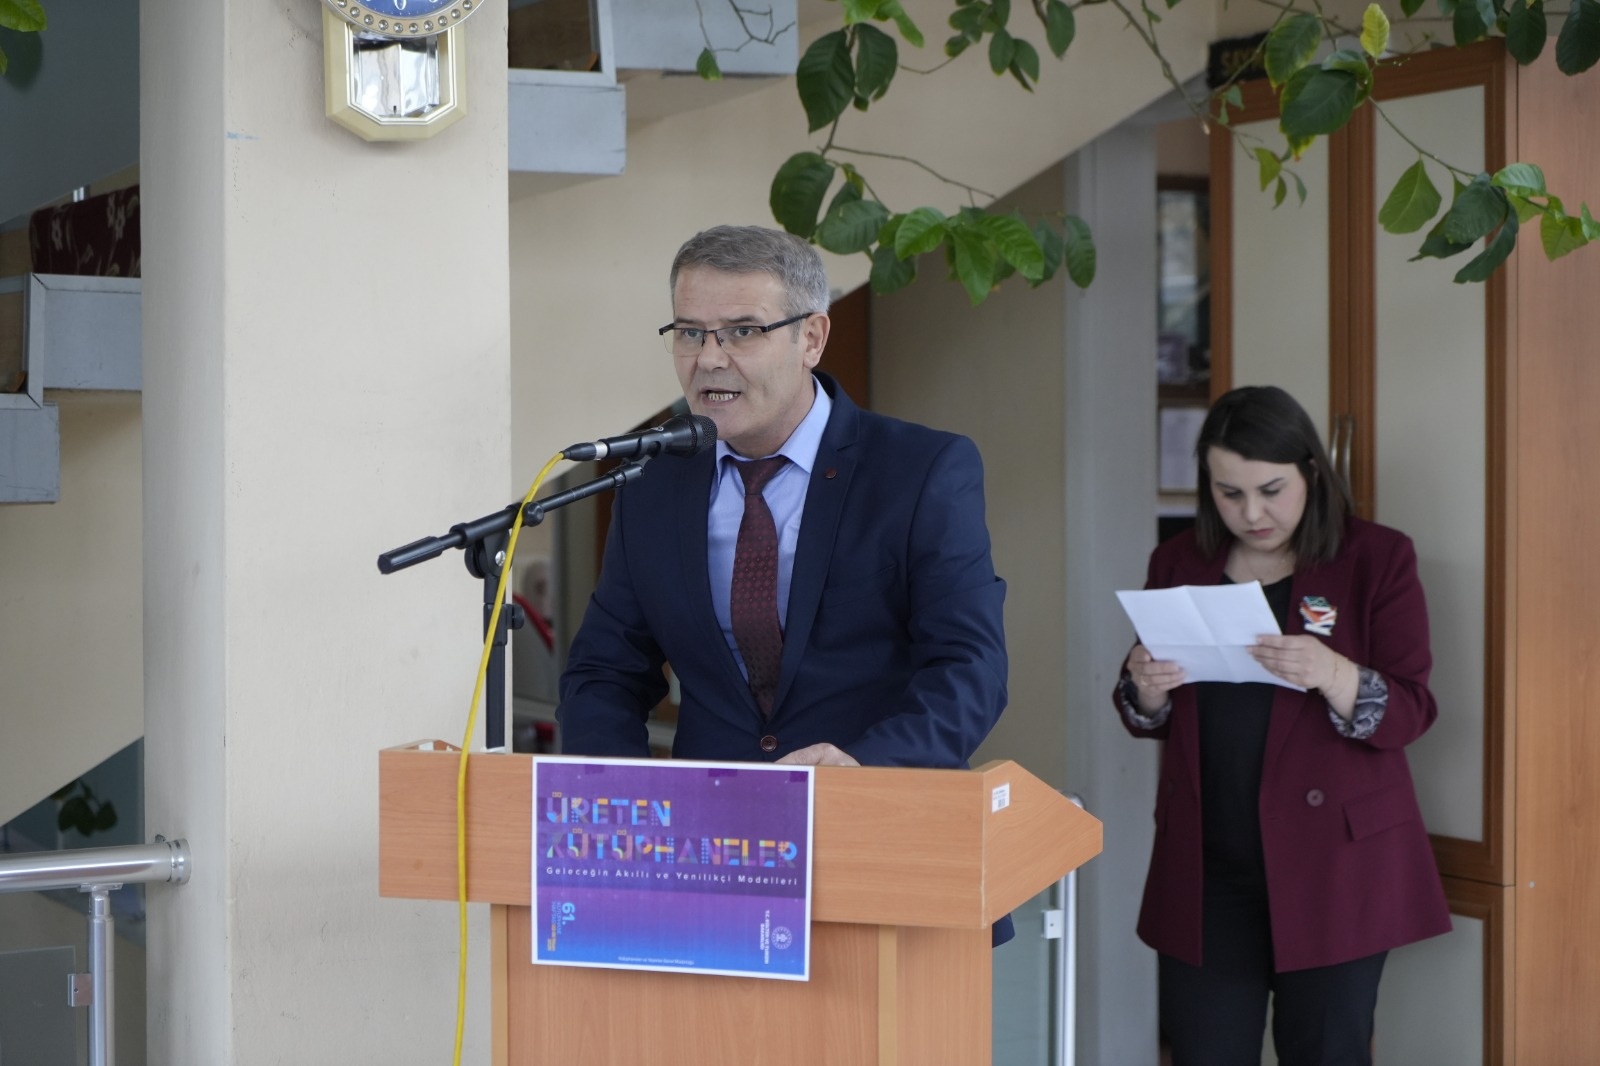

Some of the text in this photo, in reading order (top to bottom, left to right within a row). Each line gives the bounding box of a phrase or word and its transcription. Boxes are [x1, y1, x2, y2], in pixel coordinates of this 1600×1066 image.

[546, 791, 671, 827] ÜRETEN
[546, 828, 798, 868] KÜTÜPHANELER
[546, 866, 609, 878] Geleceğin
[675, 872, 732, 883] Yenilikçi
[737, 874, 798, 886] Modelleri
[562, 902, 575, 925] 61.
